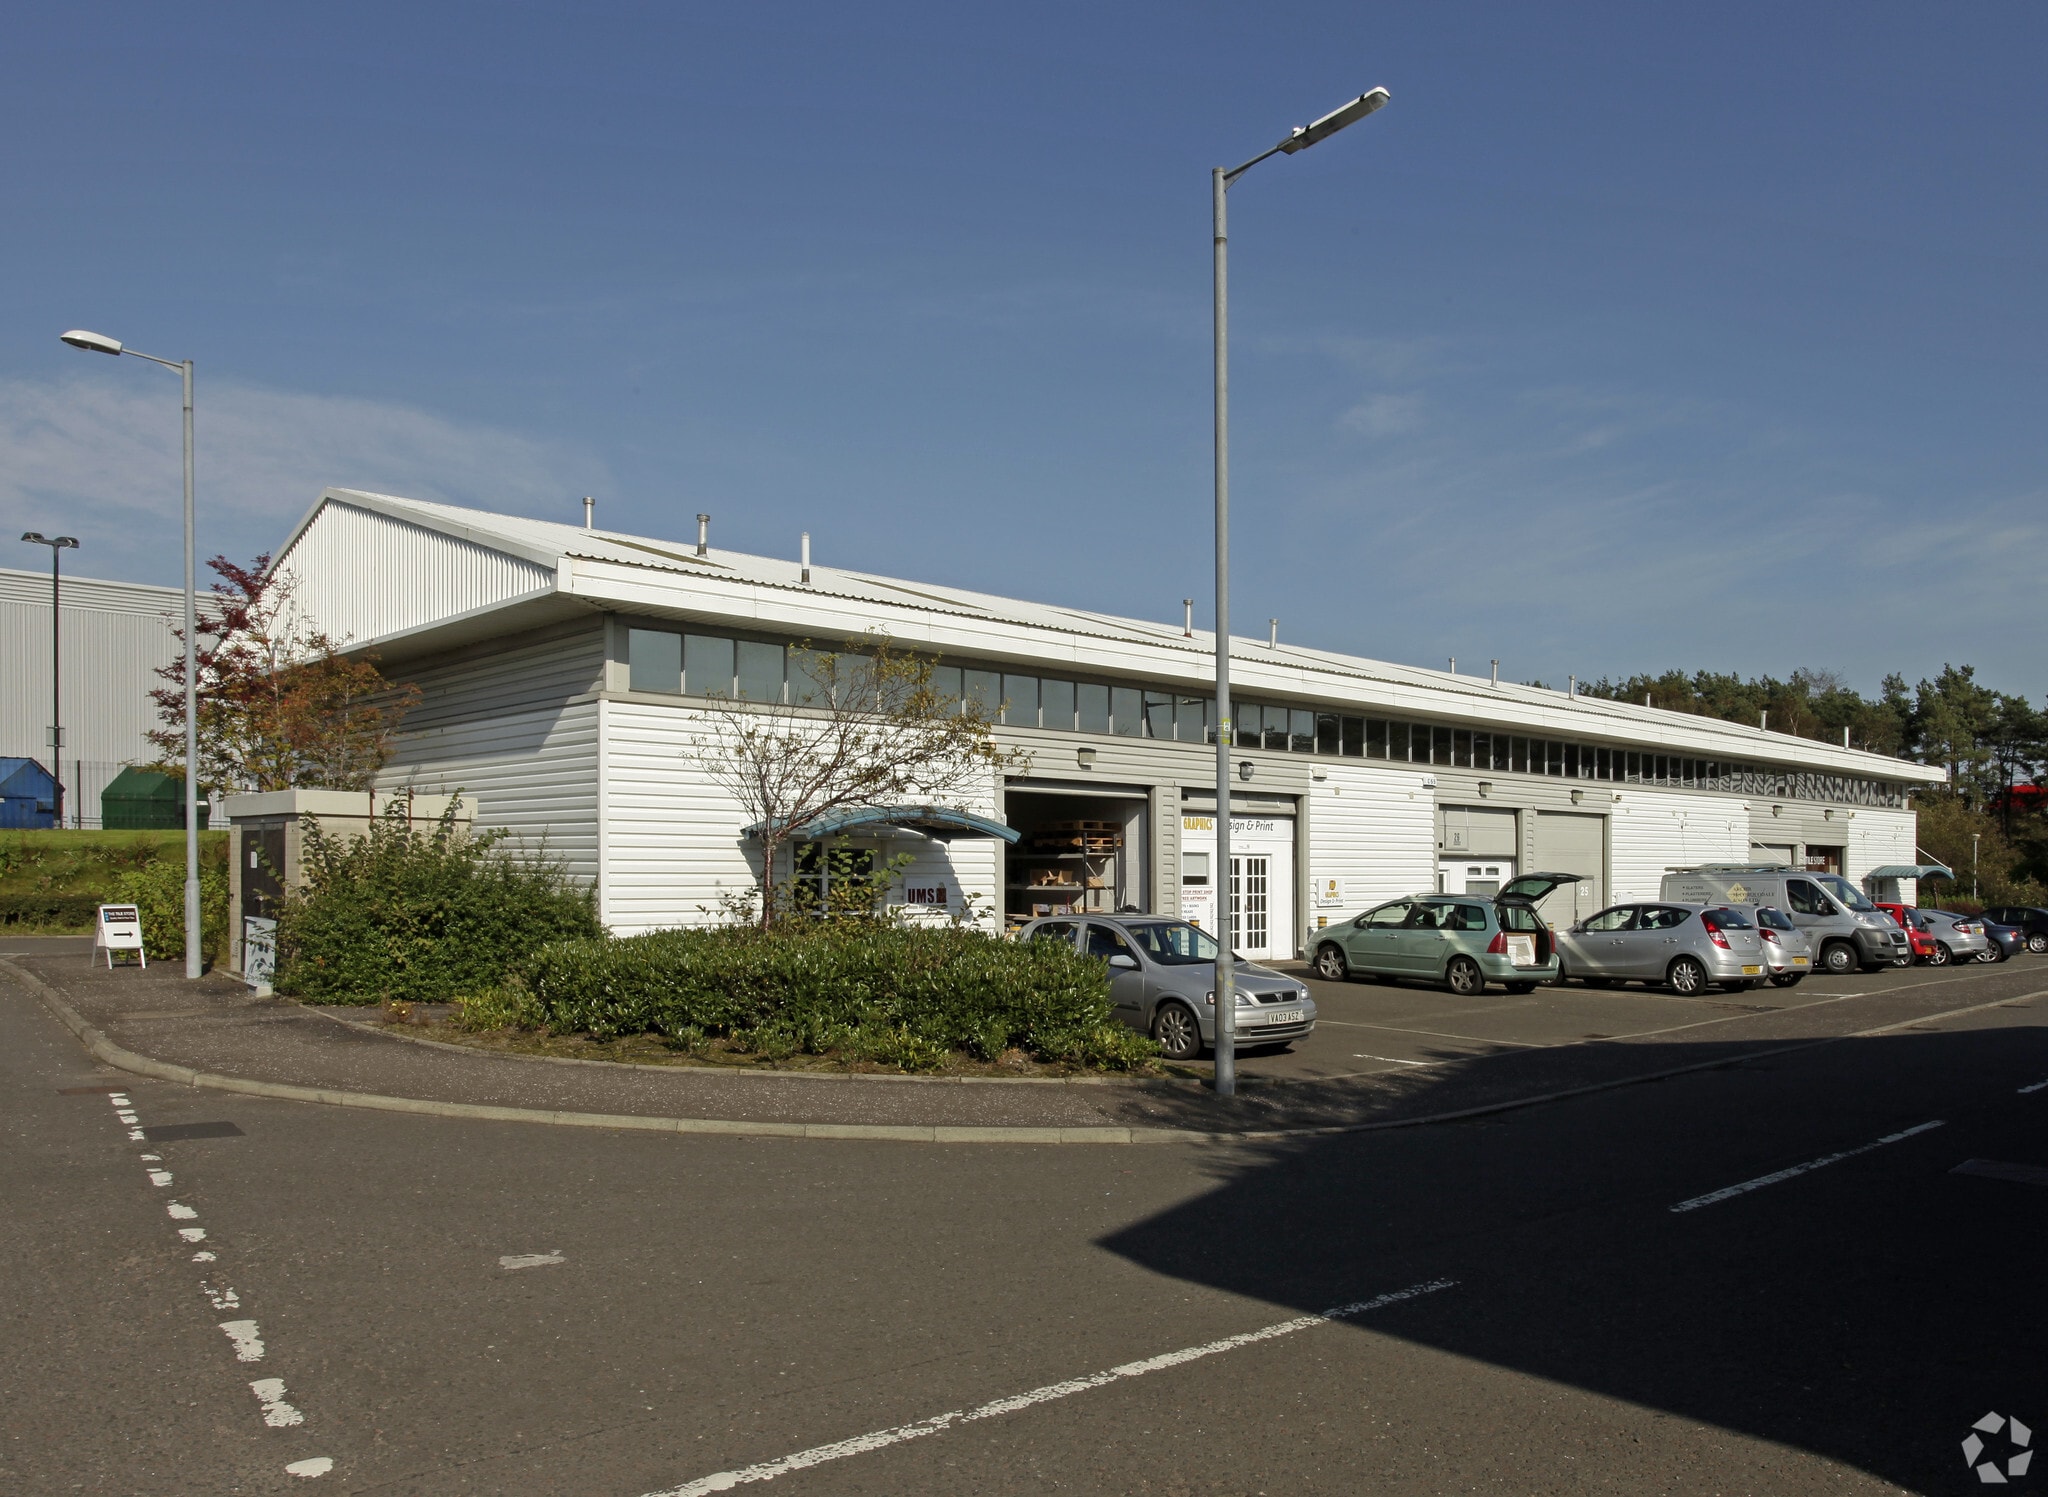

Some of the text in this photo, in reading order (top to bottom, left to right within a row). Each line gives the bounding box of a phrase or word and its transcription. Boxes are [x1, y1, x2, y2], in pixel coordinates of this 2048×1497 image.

[1184, 817, 1213, 830] GRAPHICS
[1246, 820, 1254, 831] &
[1255, 821, 1274, 832] Print
[907, 888, 935, 904] UMS
[1580, 886, 1589, 896] 25
[1271, 1013, 1286, 1022] VA03
